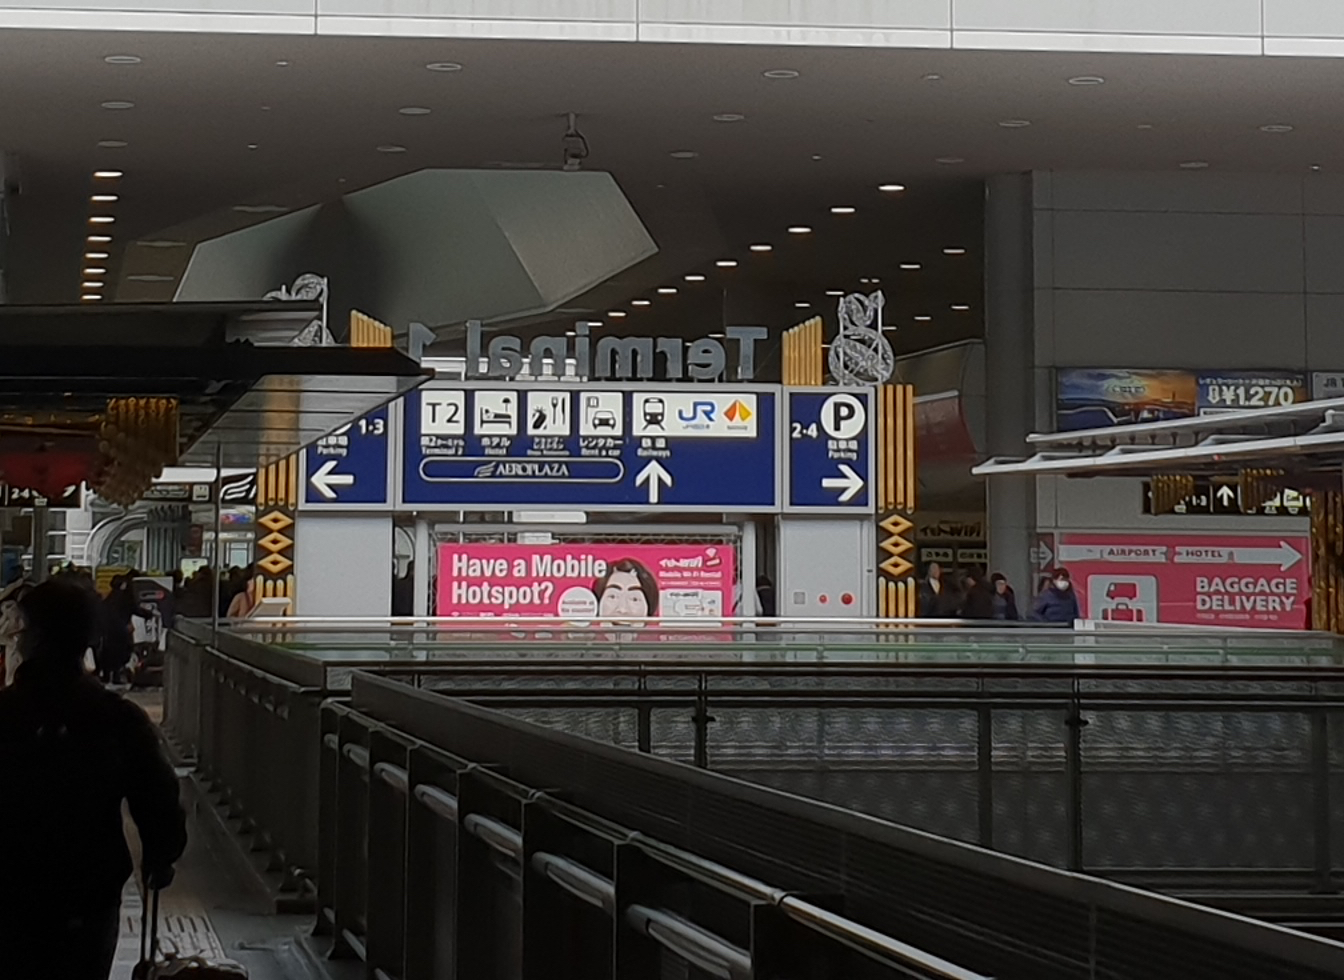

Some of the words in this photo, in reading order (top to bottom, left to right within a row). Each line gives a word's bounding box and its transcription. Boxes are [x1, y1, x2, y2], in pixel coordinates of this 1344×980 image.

[426, 402, 460, 424] T2
[678, 401, 715, 422] JR
[833, 401, 855, 431] P
[580, 436, 623, 447] レンタカー
[495, 463, 570, 477] AEROPLAZA
[1107, 549, 1158, 557] AIRPORT
[1185, 549, 1223, 558] HOTEL
[452, 554, 507, 577] Have
[512, 559, 526, 577] a
[532, 554, 607, 577] Mobile
[1196, 577, 1297, 593] BAGGAGE
[452, 581, 554, 608] Hotspot?
[1196, 595, 1295, 611] DELIVERY
